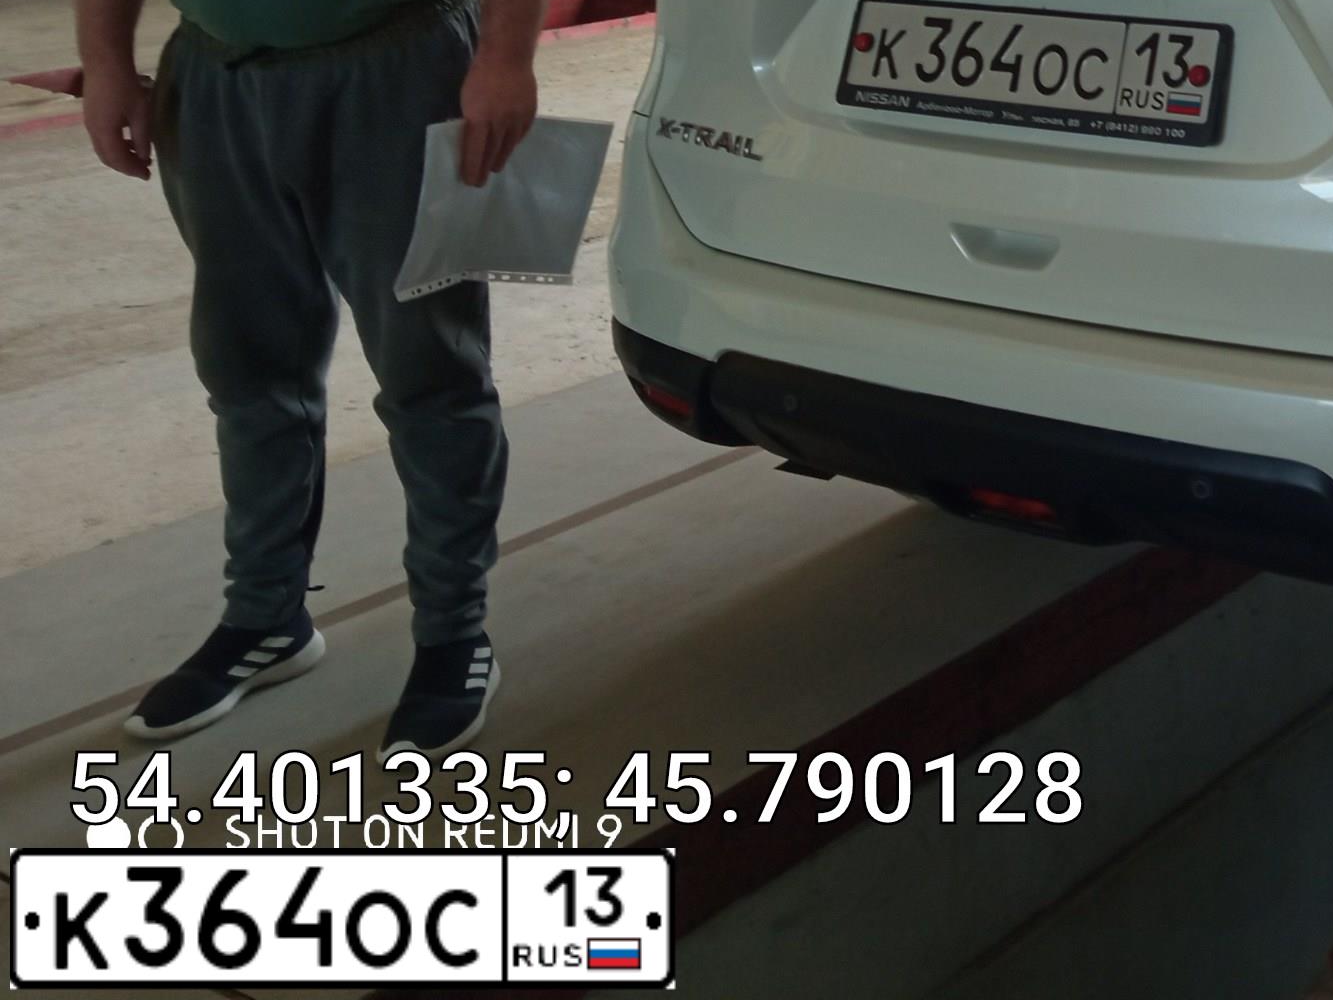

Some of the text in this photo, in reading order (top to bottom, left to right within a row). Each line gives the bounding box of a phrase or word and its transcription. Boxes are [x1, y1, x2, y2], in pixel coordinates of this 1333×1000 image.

[1135, 32, 1195, 88] 13
[855, 90, 911, 109] NISSAN
[1119, 87, 1166, 112] RUS
[656, 116, 763, 162] X-TRAIL
